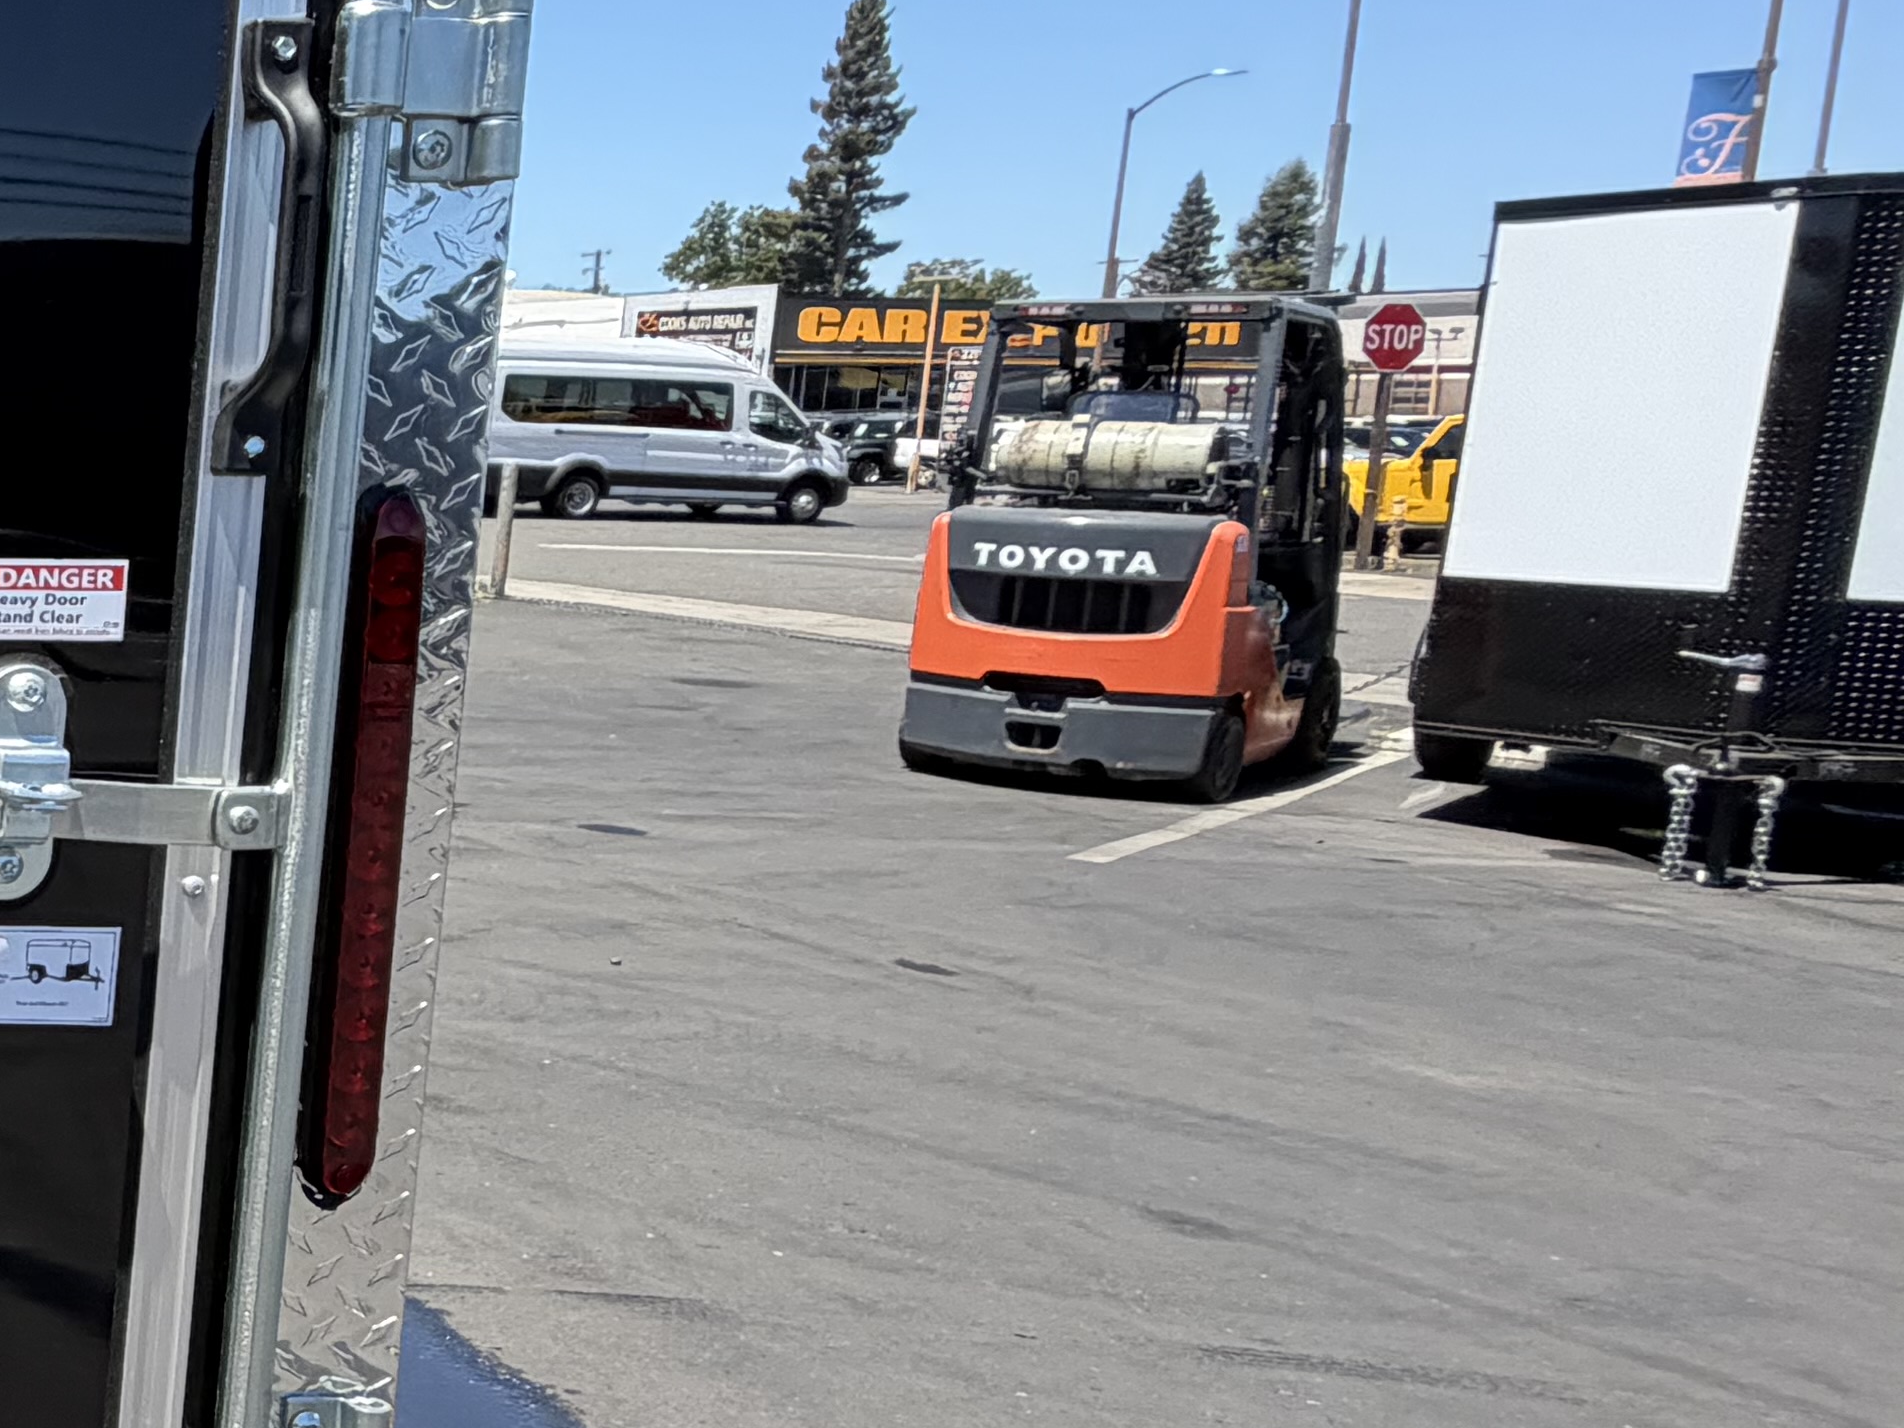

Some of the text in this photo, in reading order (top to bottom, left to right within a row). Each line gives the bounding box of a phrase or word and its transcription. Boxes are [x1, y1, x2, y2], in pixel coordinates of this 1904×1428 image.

[688, 315, 711, 330] AUTO
[712, 314, 745, 329] REPAIR
[797, 306, 928, 343] CAR
[1365, 323, 1423, 351] STOP
[973, 541, 1159, 576] TOYOTA
[44, 593, 88, 606] Door
[39, 609, 83, 625] Clear
